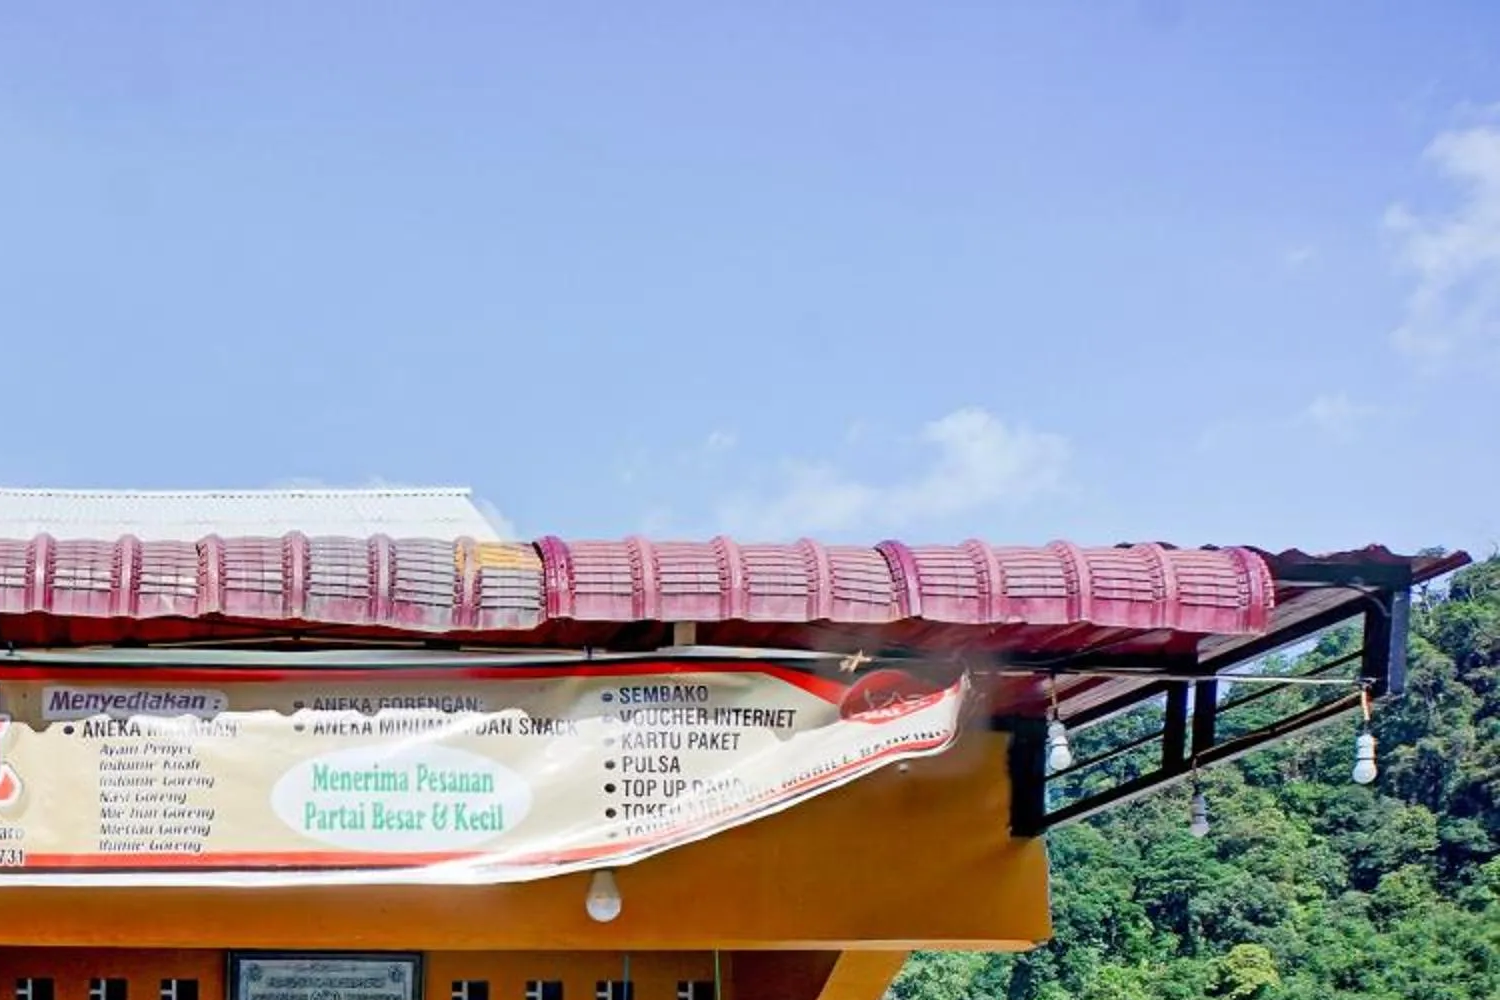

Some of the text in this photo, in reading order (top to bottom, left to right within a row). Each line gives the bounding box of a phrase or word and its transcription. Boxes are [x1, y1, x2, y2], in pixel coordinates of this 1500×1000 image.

[49, 691, 206, 712] Menyediakan
[619, 685, 709, 704] SEMBAKO
[313, 697, 373, 714] ANEKA
[313, 718, 580, 736] ANEKA MINUM DAN SNACK
[619, 708, 797, 728] VOUCHER INTERNET
[82, 719, 238, 738] ANEKA ANAN
[621, 731, 741, 751] KARTU PAKET
[622, 755, 681, 773] PULSA
[312, 763, 495, 793] Menerima Pesanan
[622, 779, 656, 797] TOP
[663, 779, 687, 798] UP
[304, 801, 504, 832] Partai Besar & Kecil
